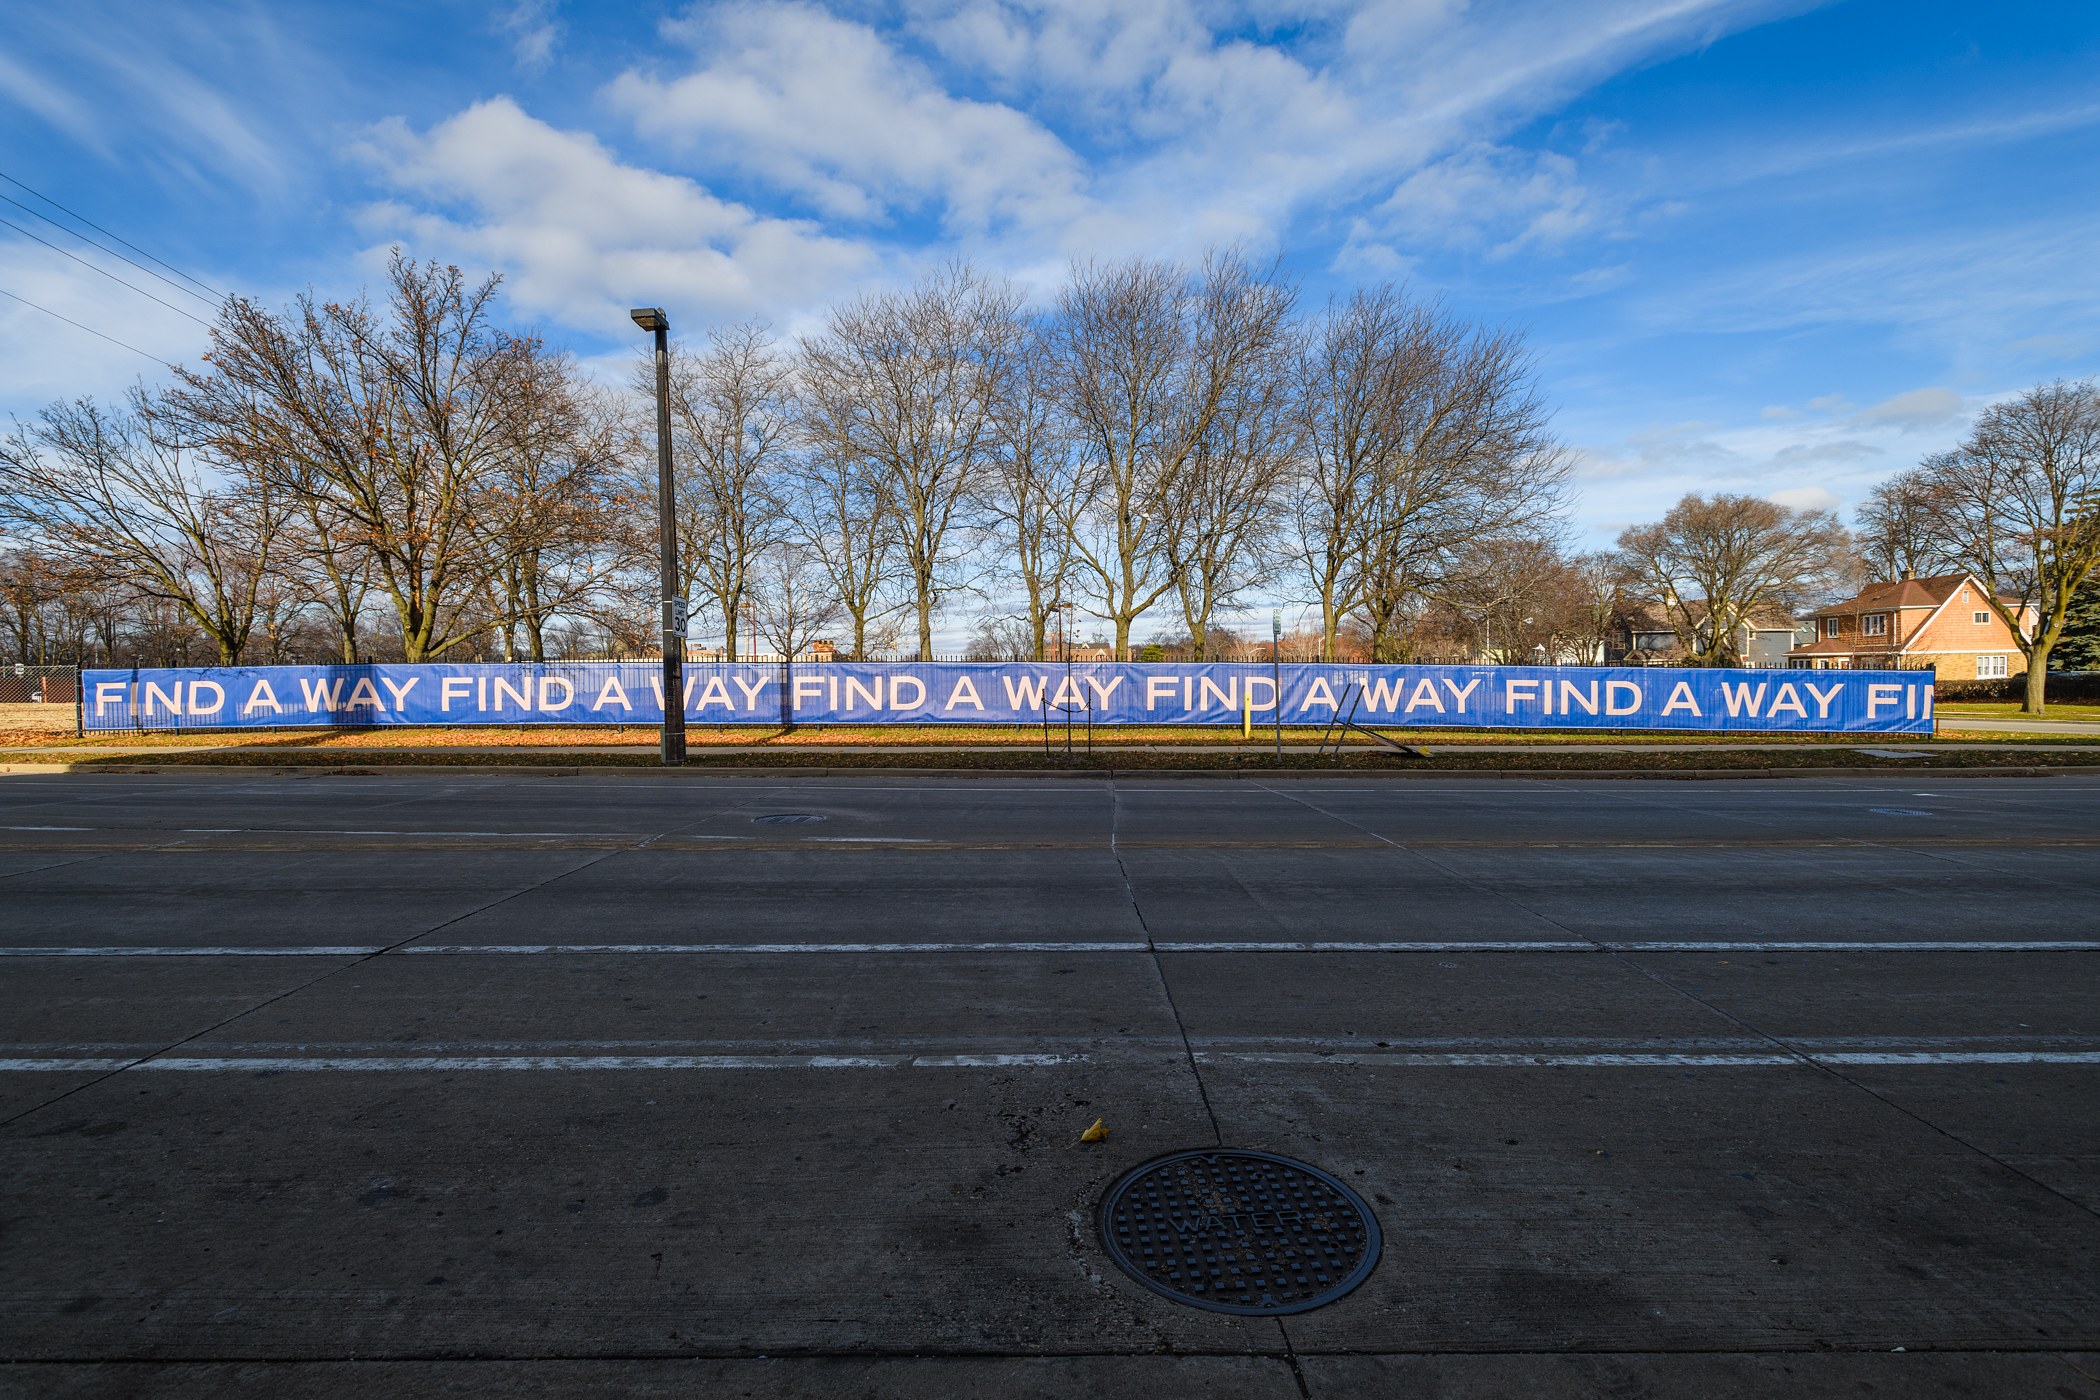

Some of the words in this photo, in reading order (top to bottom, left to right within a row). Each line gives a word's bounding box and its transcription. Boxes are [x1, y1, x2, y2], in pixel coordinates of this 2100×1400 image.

[674, 616, 686, 633] 30
[96, 680, 225, 717] FIND
[244, 679, 282, 714] A
[301, 677, 420, 712] WAY
[442, 676, 574, 711] FIND
[593, 675, 632, 711] A
[793, 675, 926, 711] FIND
[945, 675, 984, 711] A
[1003, 675, 1123, 711] WAY
[1147, 676, 1281, 712] FIND
[1301, 677, 1338, 712] A
[1360, 677, 1481, 713] WAY
[1506, 680, 1642, 716] FIND
[1662, 682, 1701, 717] A
[1722, 682, 1843, 717] WAY
[1168, 1210, 1303, 1234] WATER
